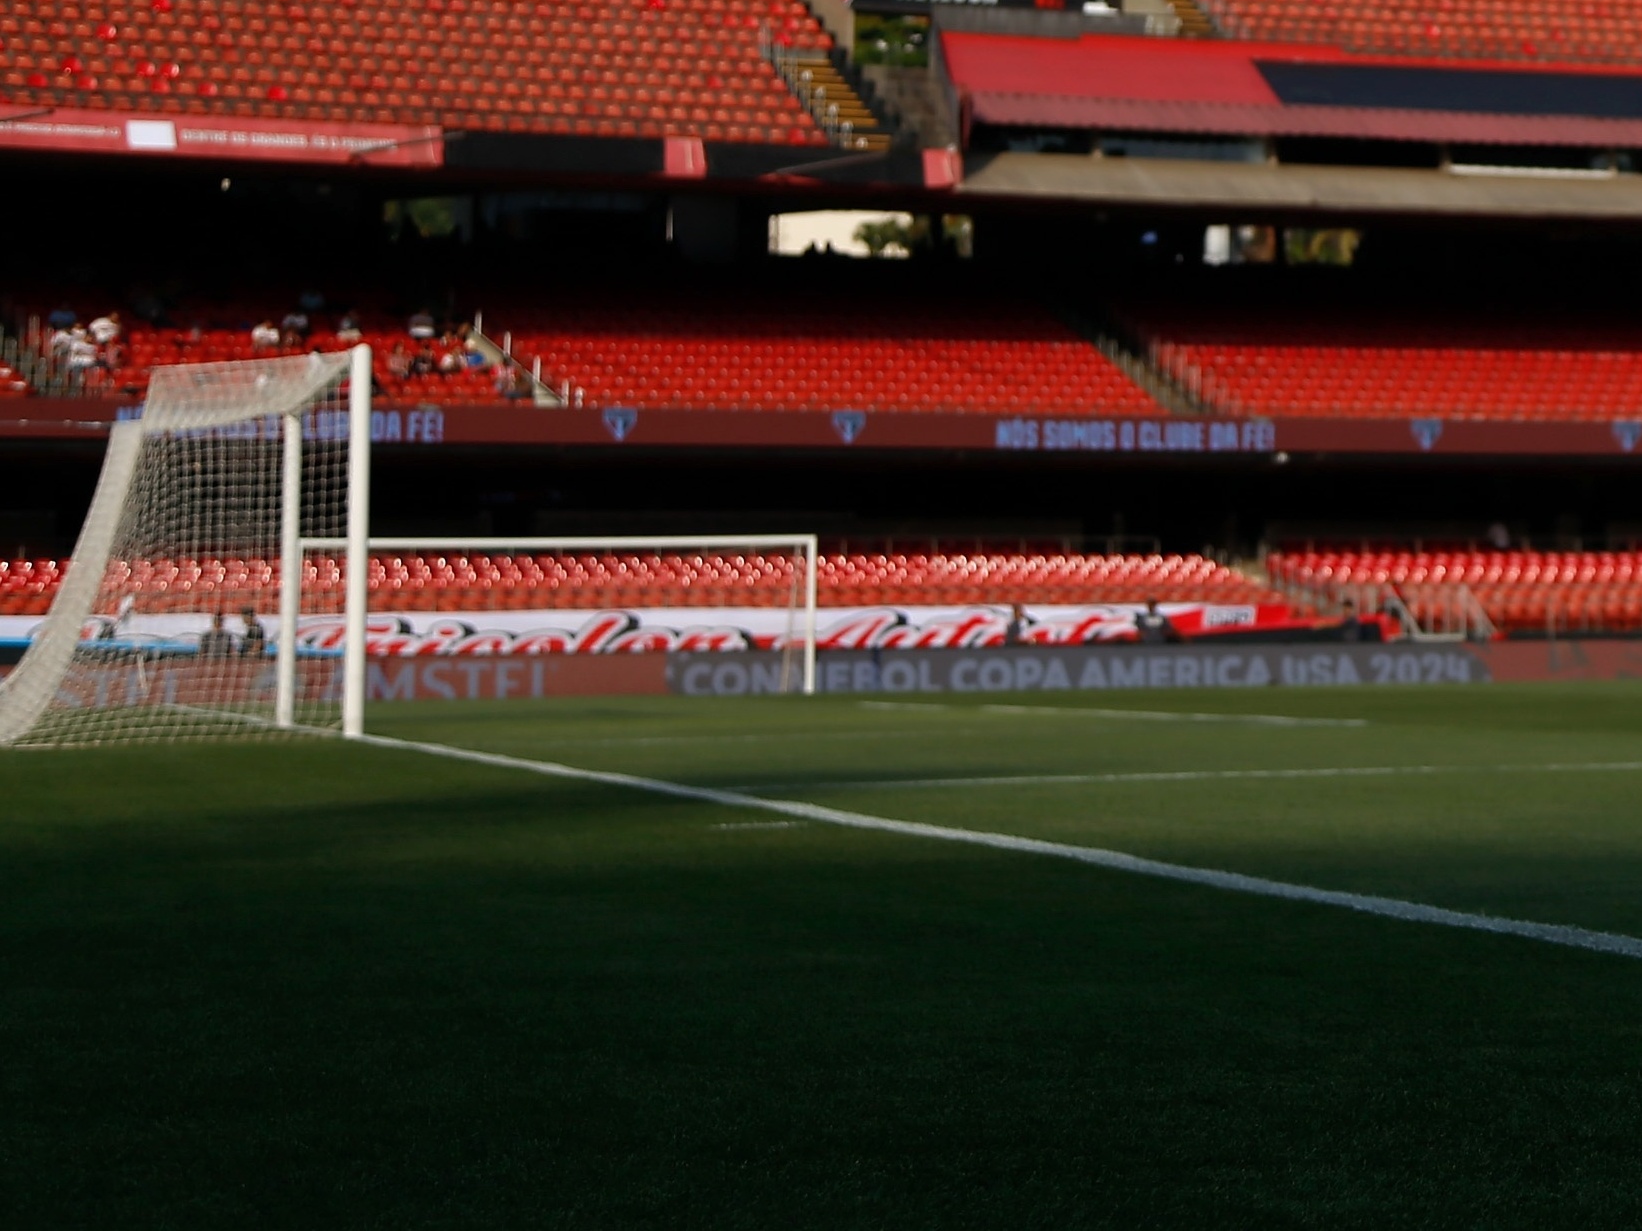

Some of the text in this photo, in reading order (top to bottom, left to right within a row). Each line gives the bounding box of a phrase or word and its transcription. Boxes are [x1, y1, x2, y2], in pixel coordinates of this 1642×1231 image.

[682, 652, 1472, 694] CONMEBOL COPA AMERICA USA 2024
